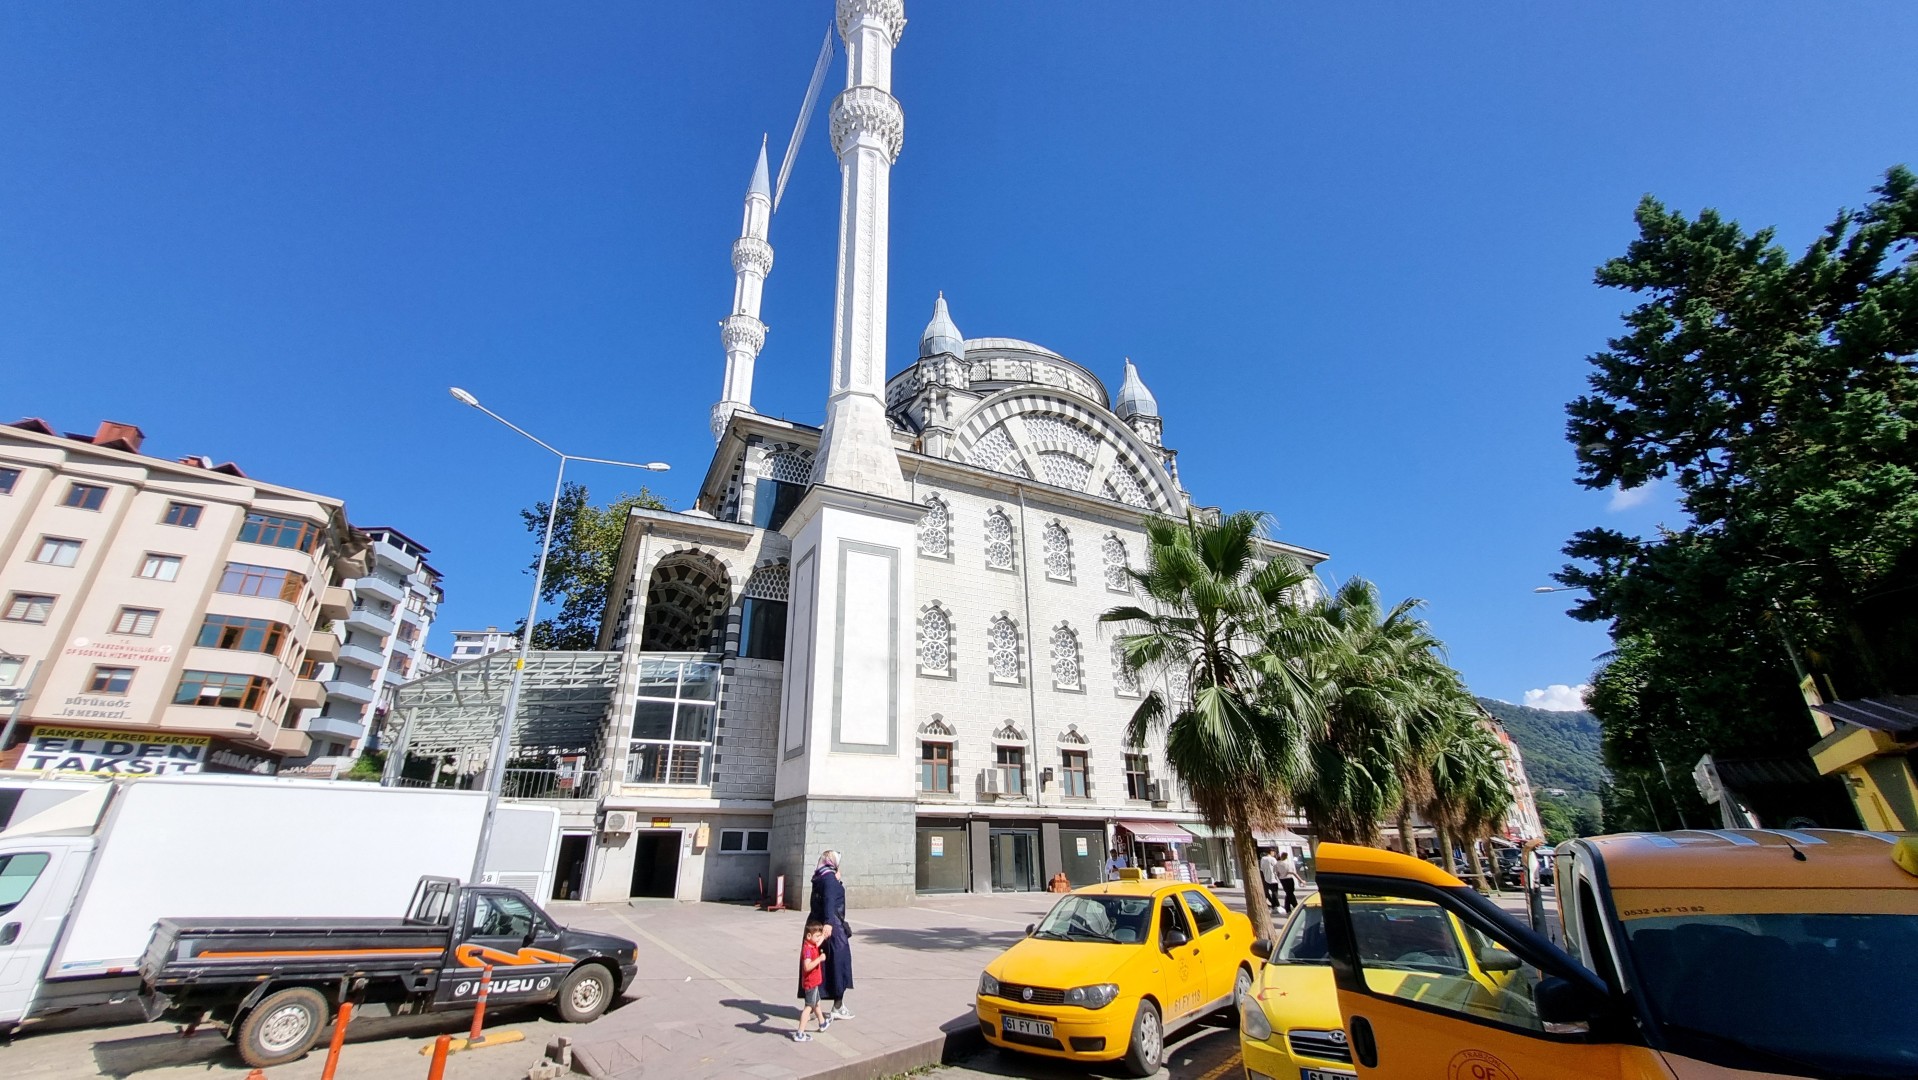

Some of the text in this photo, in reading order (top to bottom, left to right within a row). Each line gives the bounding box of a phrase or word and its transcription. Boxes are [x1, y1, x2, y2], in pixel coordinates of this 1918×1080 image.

[36, 728, 107, 740] BANKASIZ
[153, 736, 207, 746] KARTSIZ
[33, 737, 202, 760] ELDEN
[1006, 1018, 1051, 1035] 61 FY 118
[1472, 1064, 1496, 1080] OF
